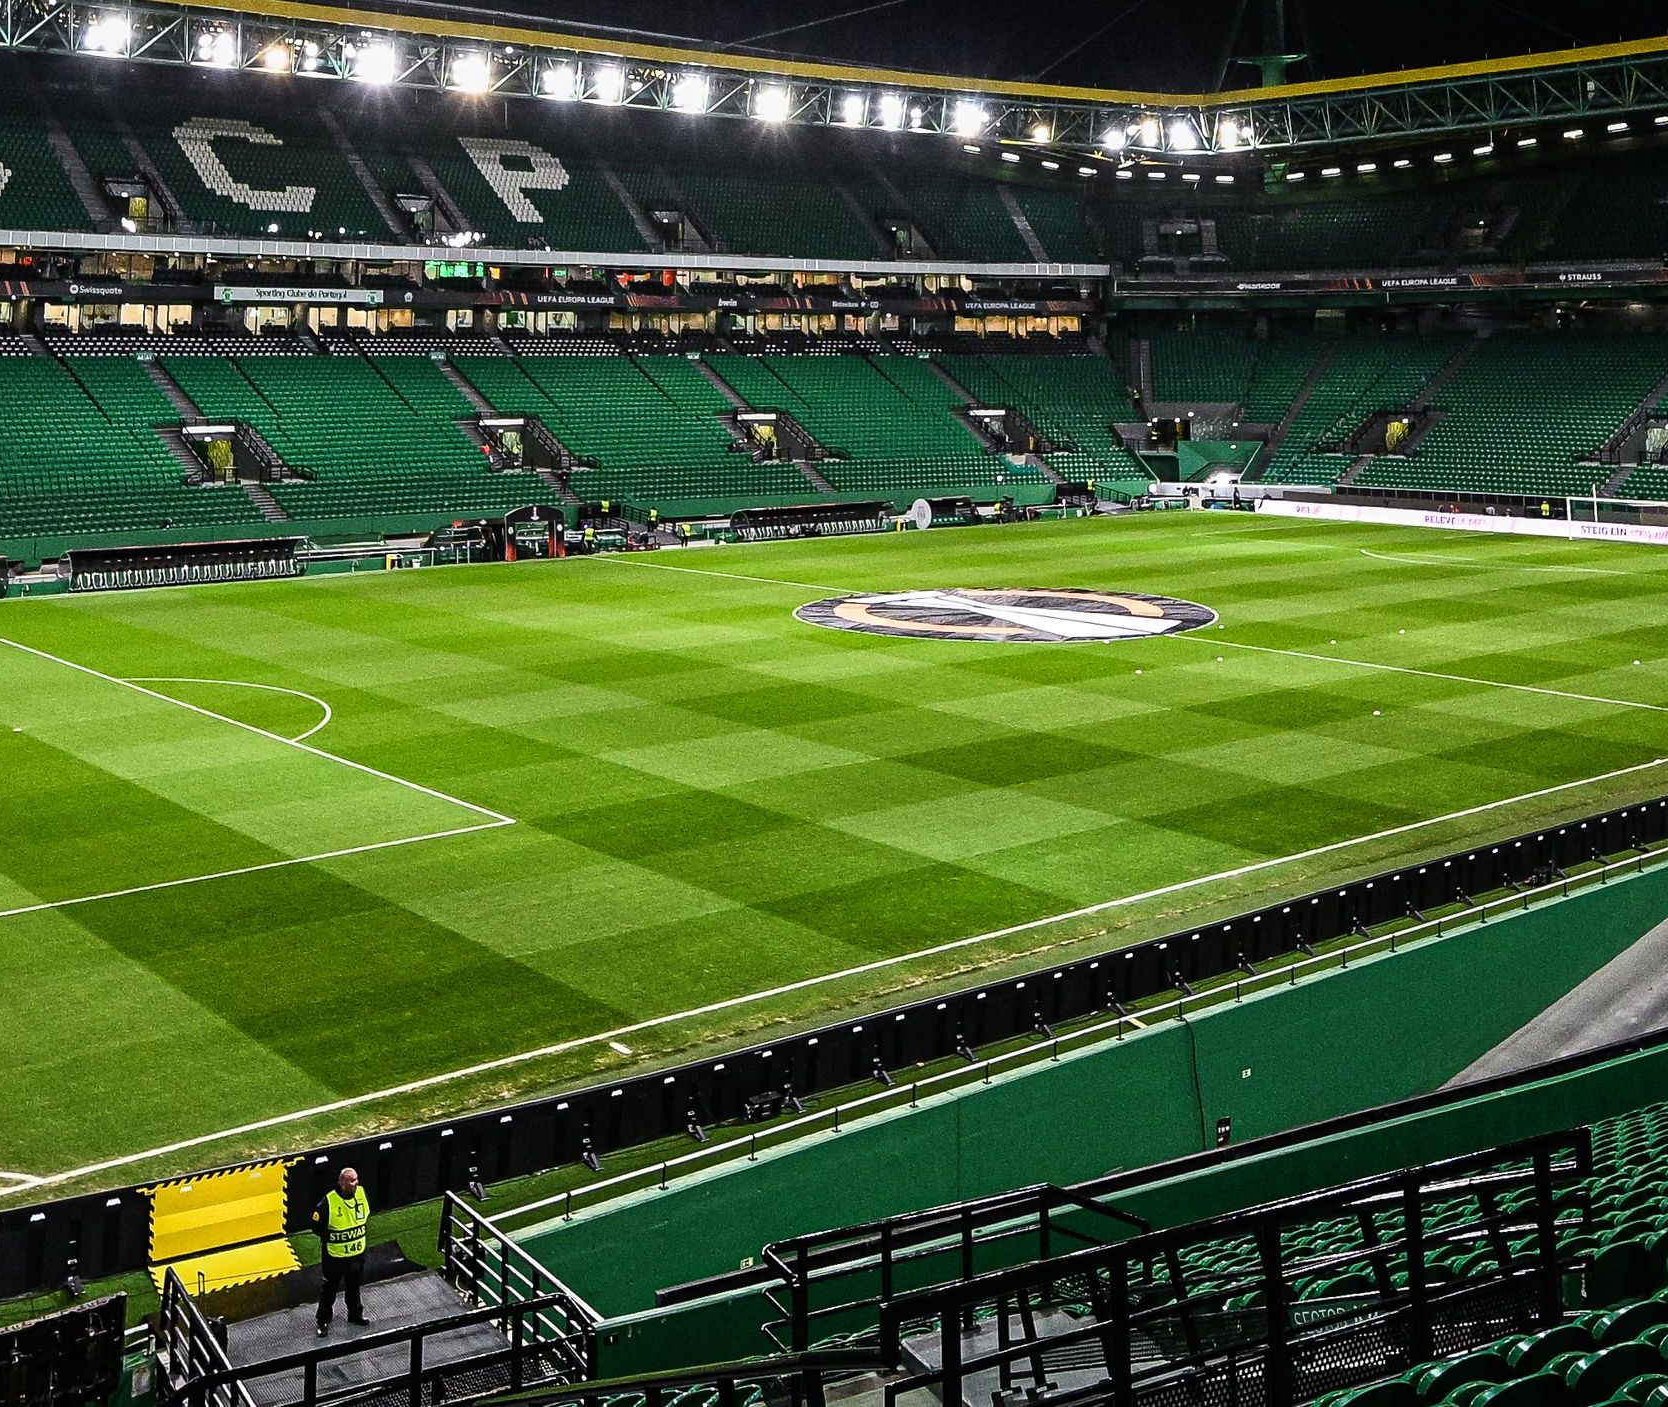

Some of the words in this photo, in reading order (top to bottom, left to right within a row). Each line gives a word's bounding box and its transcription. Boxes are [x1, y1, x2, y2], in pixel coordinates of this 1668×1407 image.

[1567, 273, 1602, 281] STRAUSS
[537, 295, 557, 303] UEFA
[558, 296, 586, 304] EUROPA
[587, 296, 615, 304] LEAGUE
[329, 1225, 366, 1241] STEWAR
